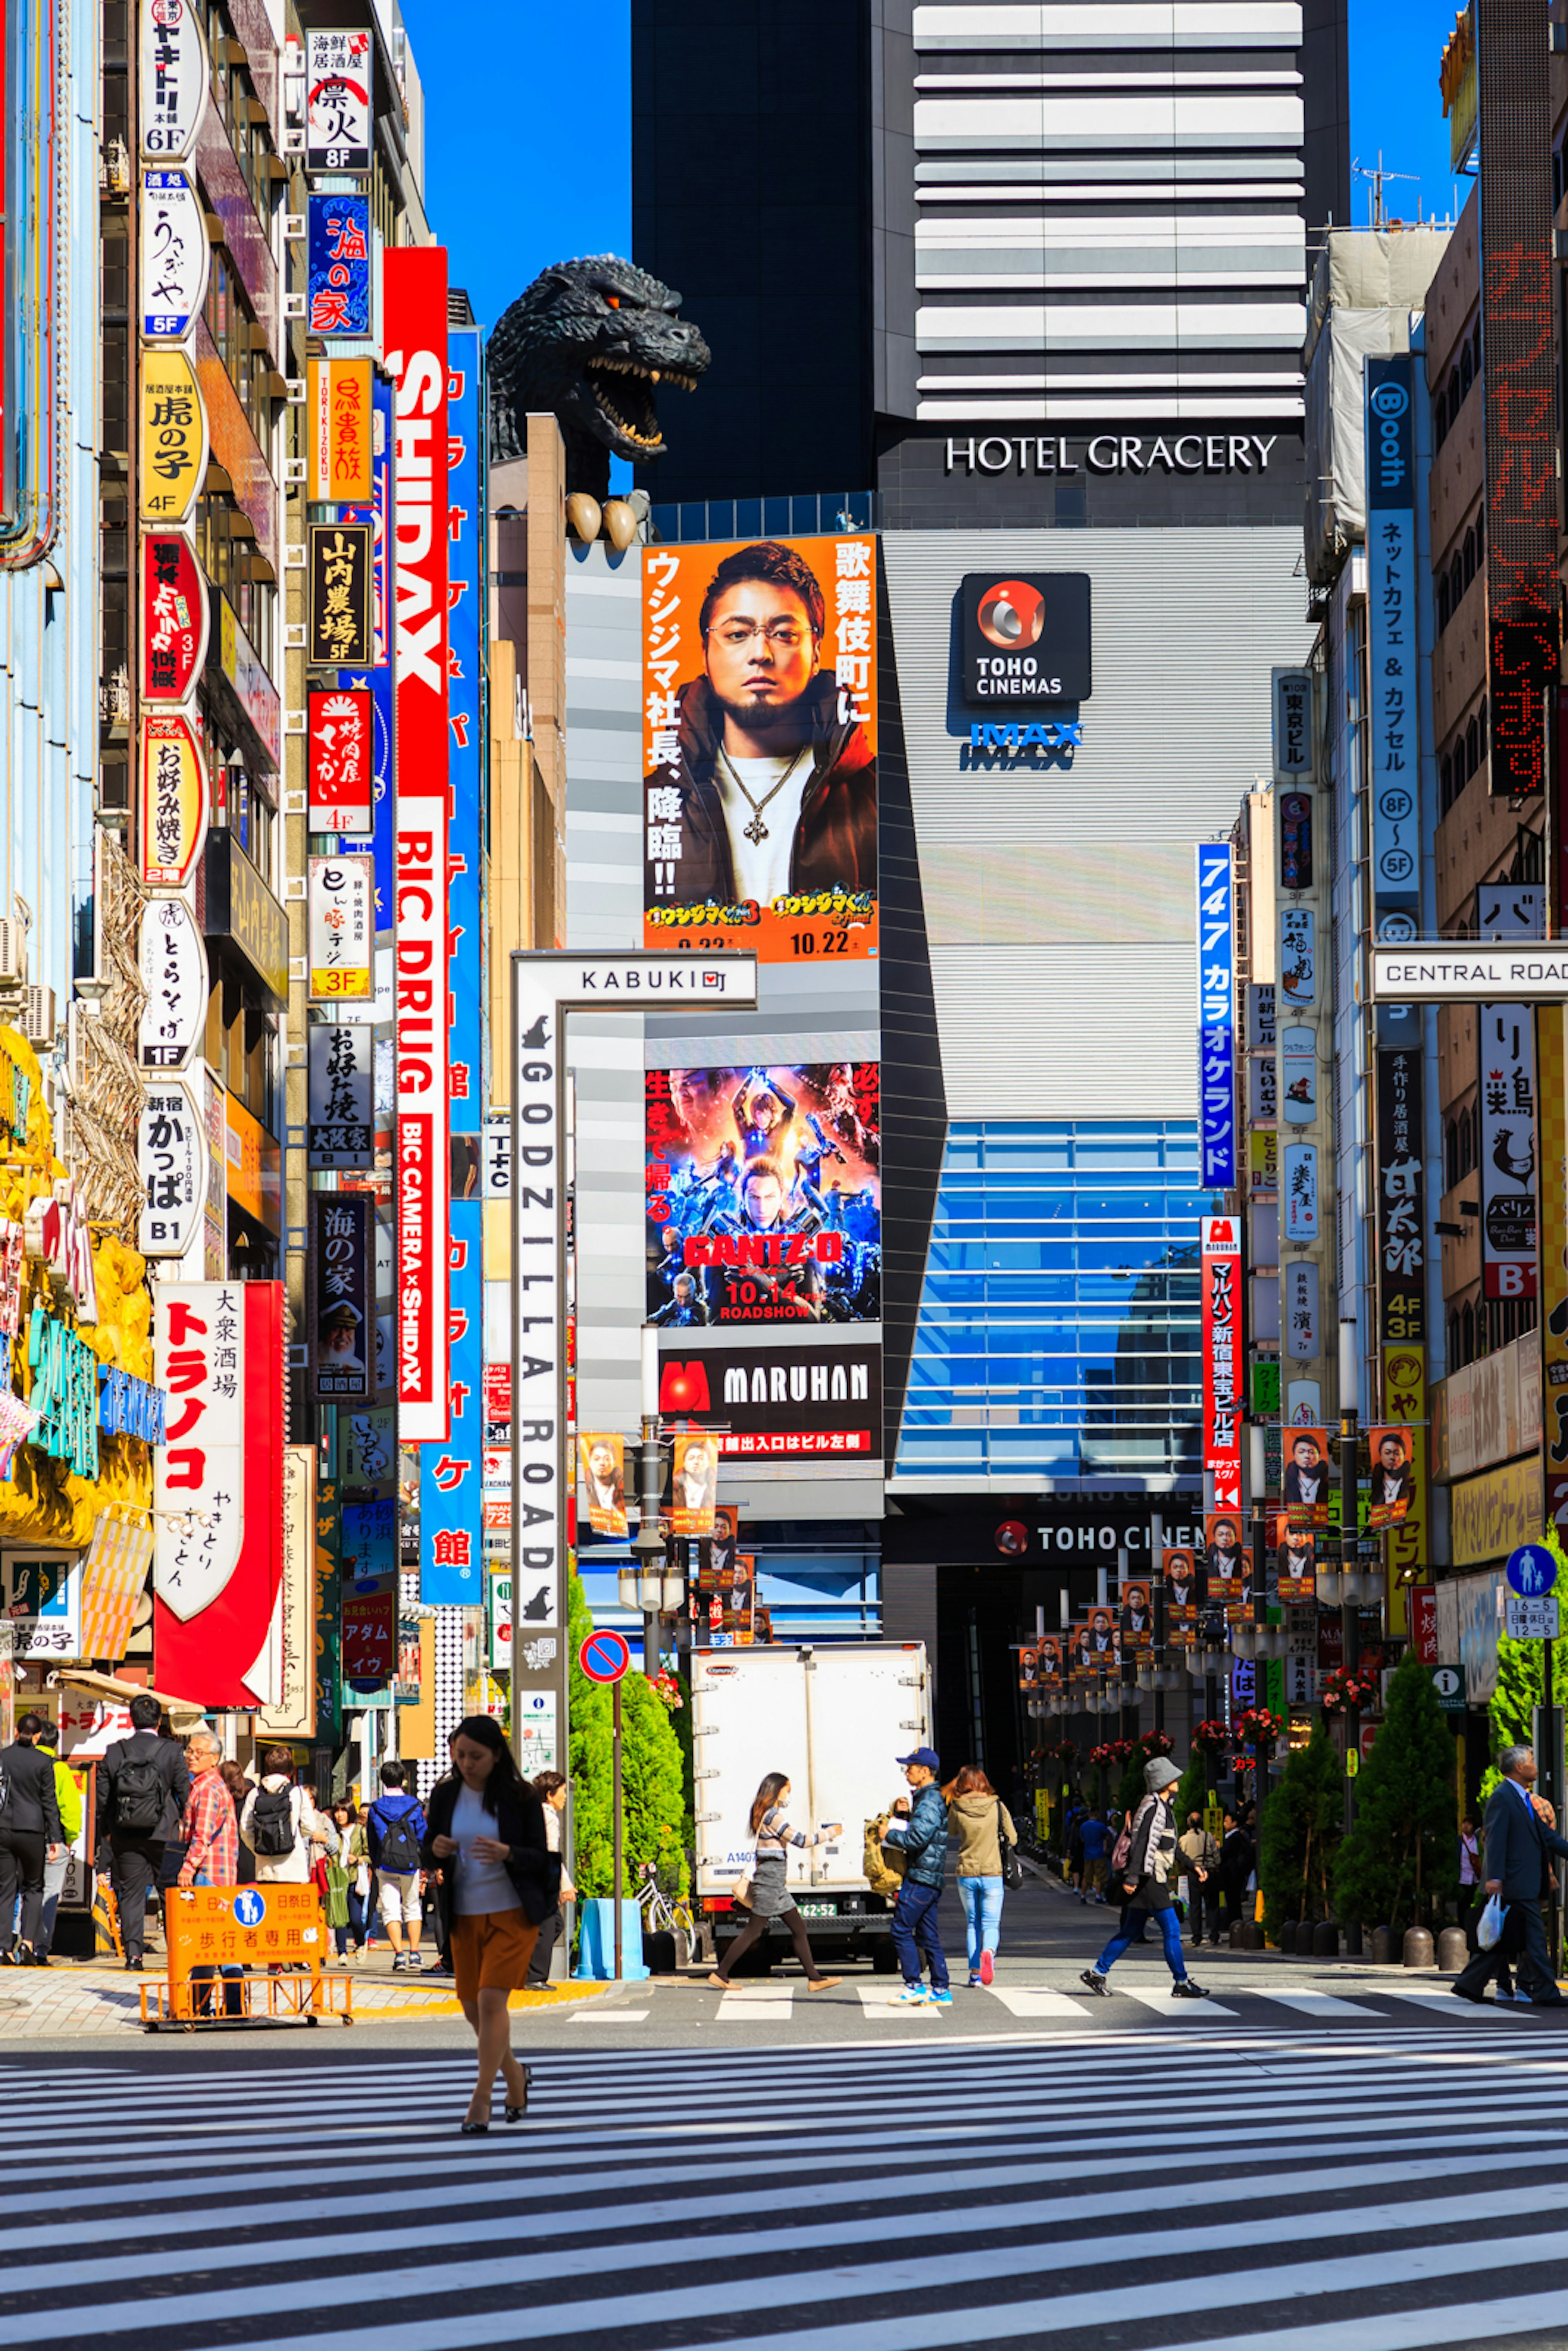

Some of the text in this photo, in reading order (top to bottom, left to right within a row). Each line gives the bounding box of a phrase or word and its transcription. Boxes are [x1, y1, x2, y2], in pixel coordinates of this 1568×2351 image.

[313, 35, 346, 51] 海鮮
[153, 23, 180, 111] ヤキトリ
[313, 53, 363, 69] 居酒屋
[147, 129, 185, 151] 6F
[325, 149, 350, 168] 8F
[148, 174, 182, 187] 酒処
[150, 210, 184, 307] うさぎや
[310, 218, 367, 332] 海の家
[153, 317, 178, 333] 5F
[145, 384, 193, 394] 居酒屋本舗
[149, 397, 193, 479] 虎の子
[335, 378, 362, 480] 鳥貴族
[1370, 381, 1409, 487] Booth
[947, 434, 1278, 470] HOTEL GRACERY
[147, 496, 176, 511] 4F
[385, 350, 443, 695] SHIDAX
[320, 532, 357, 644] 山内農場
[1382, 523, 1404, 645] ネットカフェ
[835, 541, 871, 726] 歌舞伎町に
[330, 644, 349, 659] 5F
[976, 657, 1038, 676] TOHO
[976, 678, 1062, 695] CINEMAS
[971, 722, 1085, 747] IMAX
[1286, 694, 1305, 764] 東京ビル
[1384, 686, 1406, 772] カプセル
[339, 718, 363, 783] 焼肉屋
[157, 744, 181, 865] お好み焼き
[326, 808, 353, 830] 4F
[146, 869, 180, 882] 2階
[791, 932, 849, 955] 10.22
[397, 831, 433, 1094] BIC DRUG
[1387, 964, 1501, 981] CENTRAL
[159, 933, 184, 1039] とらそば
[326, 971, 356, 991] 3F
[1291, 1008, 1307, 1017] 4F
[151, 1047, 179, 1065] 1F
[325, 1028, 359, 1123] お好み焼
[147, 1097, 183, 1111] 新宿
[1392, 1055, 1409, 1153] 手作り居酒屋
[401, 1122, 422, 1162] BIC
[147, 1114, 184, 1209] かっぱ
[151, 1222, 180, 1240] B1
[1381, 1155, 1423, 1277] 甘太郎
[325, 1206, 356, 1295] 海の家
[726, 1280, 797, 1305] 10.14
[1296, 1273, 1308, 1307] 鉄板焼
[1388, 1293, 1421, 1315] 4F
[521, 1062, 554, 1569] GODZILLA ROAD
[720, 1306, 810, 1320] ROADSHOW
[1388, 1317, 1421, 1339] 3F
[213, 1289, 239, 1399] 大衆酒場
[1211, 1262, 1234, 1448] マルハン新宿東宝ビル店
[1296, 1362, 1312, 1370] 7F
[166, 1302, 207, 1490] トラノコ
[723, 1364, 868, 1404] MARUHAN
[375, 1503, 394, 1541] 砂浜
[1037, 1527, 1116, 1550] TOHO
[345, 1625, 388, 1640] アダム
[200, 1928, 301, 1949] 歩行者専用
